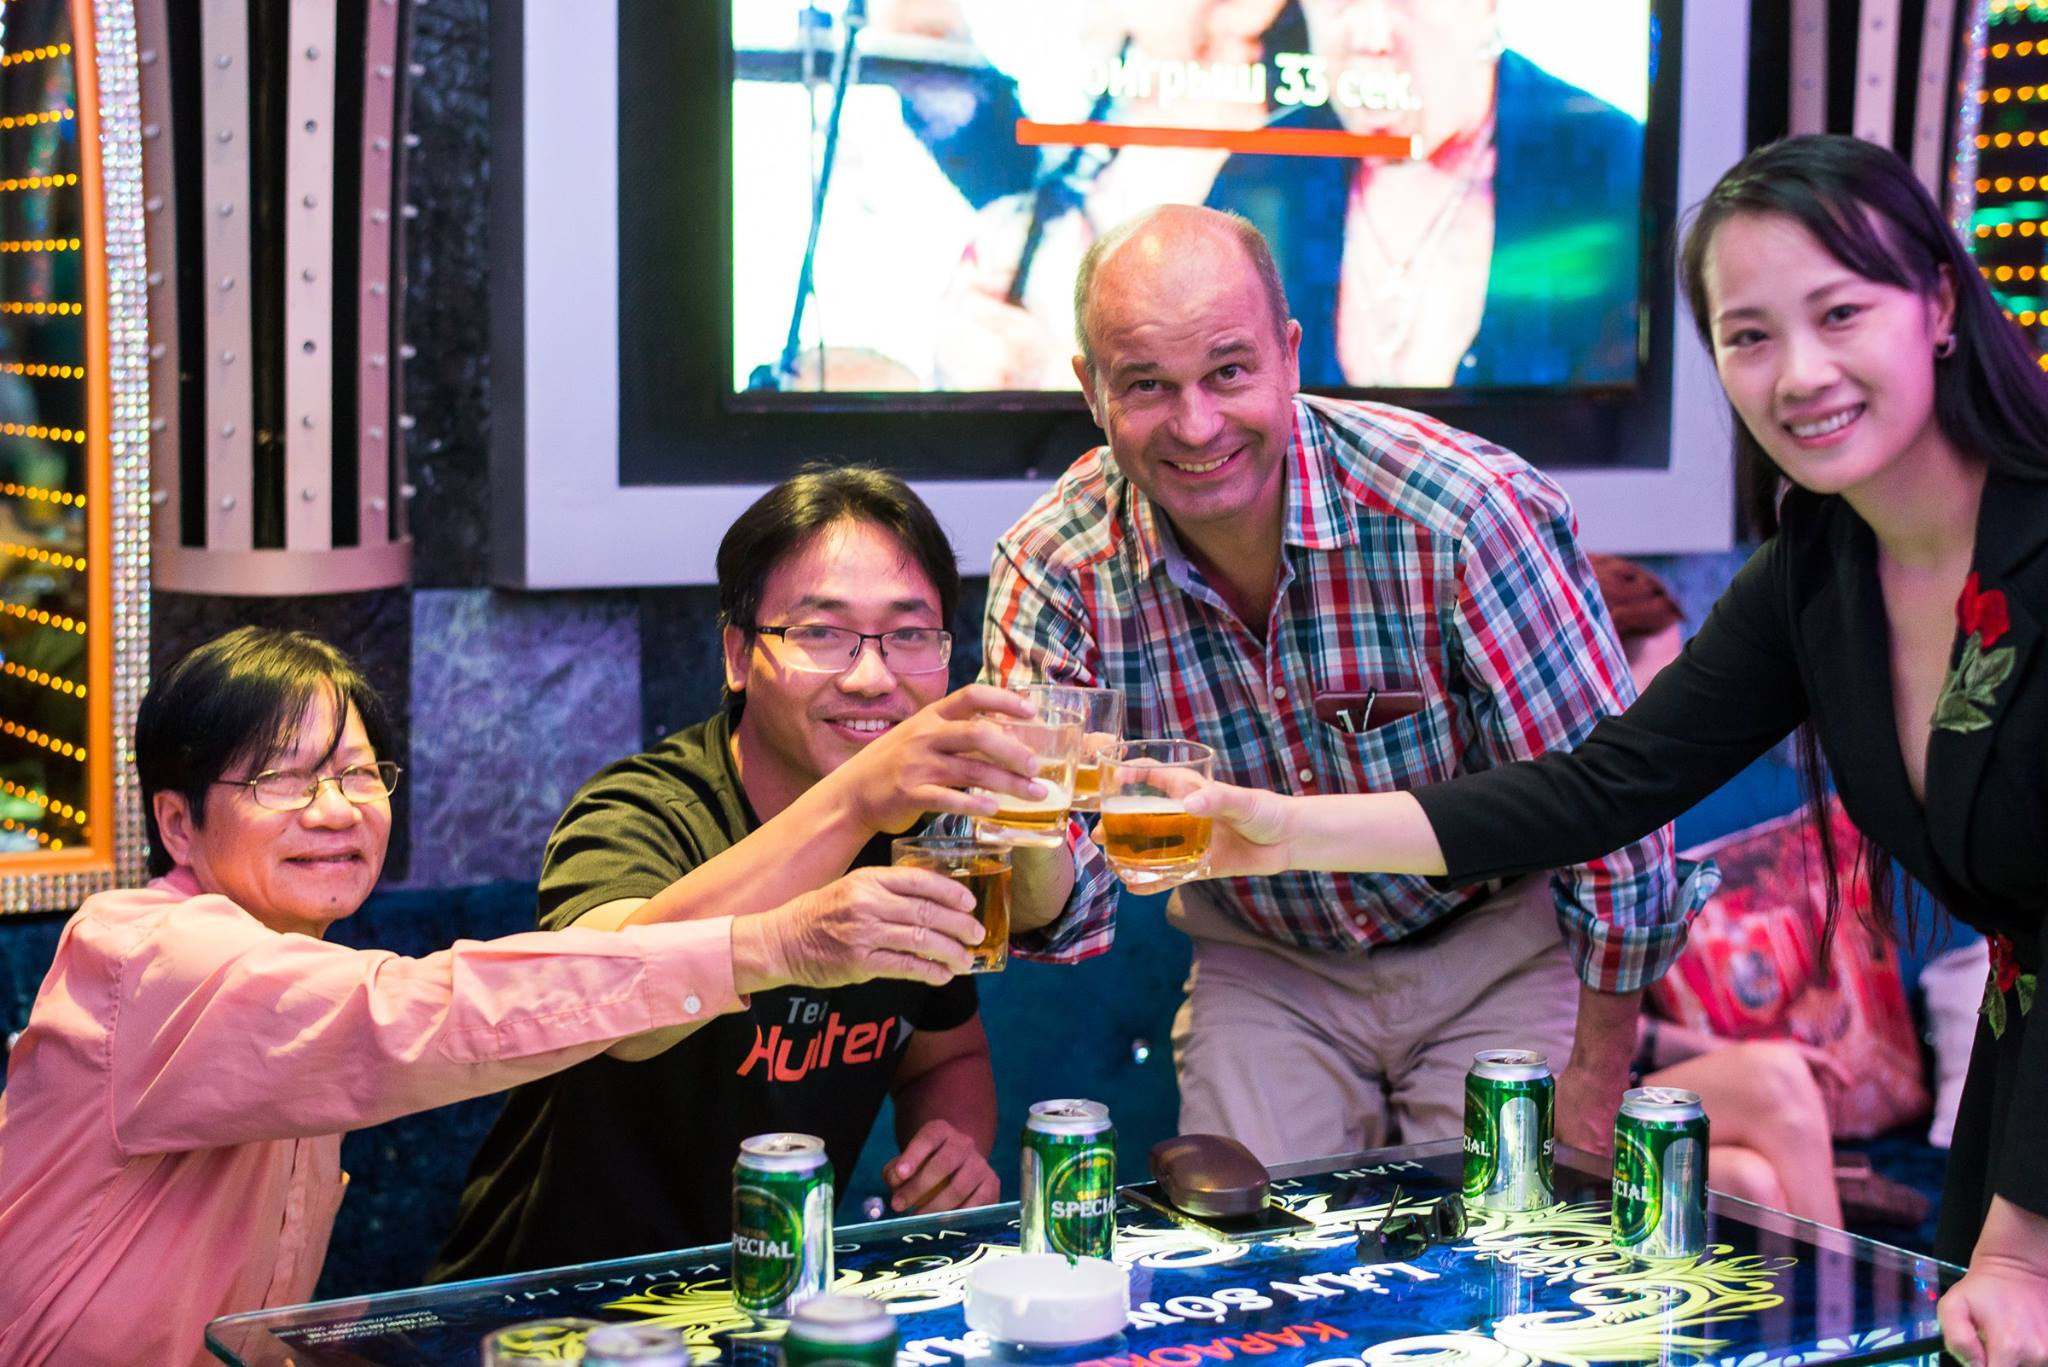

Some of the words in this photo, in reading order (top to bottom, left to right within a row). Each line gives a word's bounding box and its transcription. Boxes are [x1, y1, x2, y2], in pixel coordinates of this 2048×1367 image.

[1274, 52, 1330, 107] 33
[787, 996, 829, 1024] Te
[1463, 1134, 1491, 1157] CIAL
[1051, 1194, 1118, 1219] SPECIA
[732, 1231, 796, 1259] PECIAL
